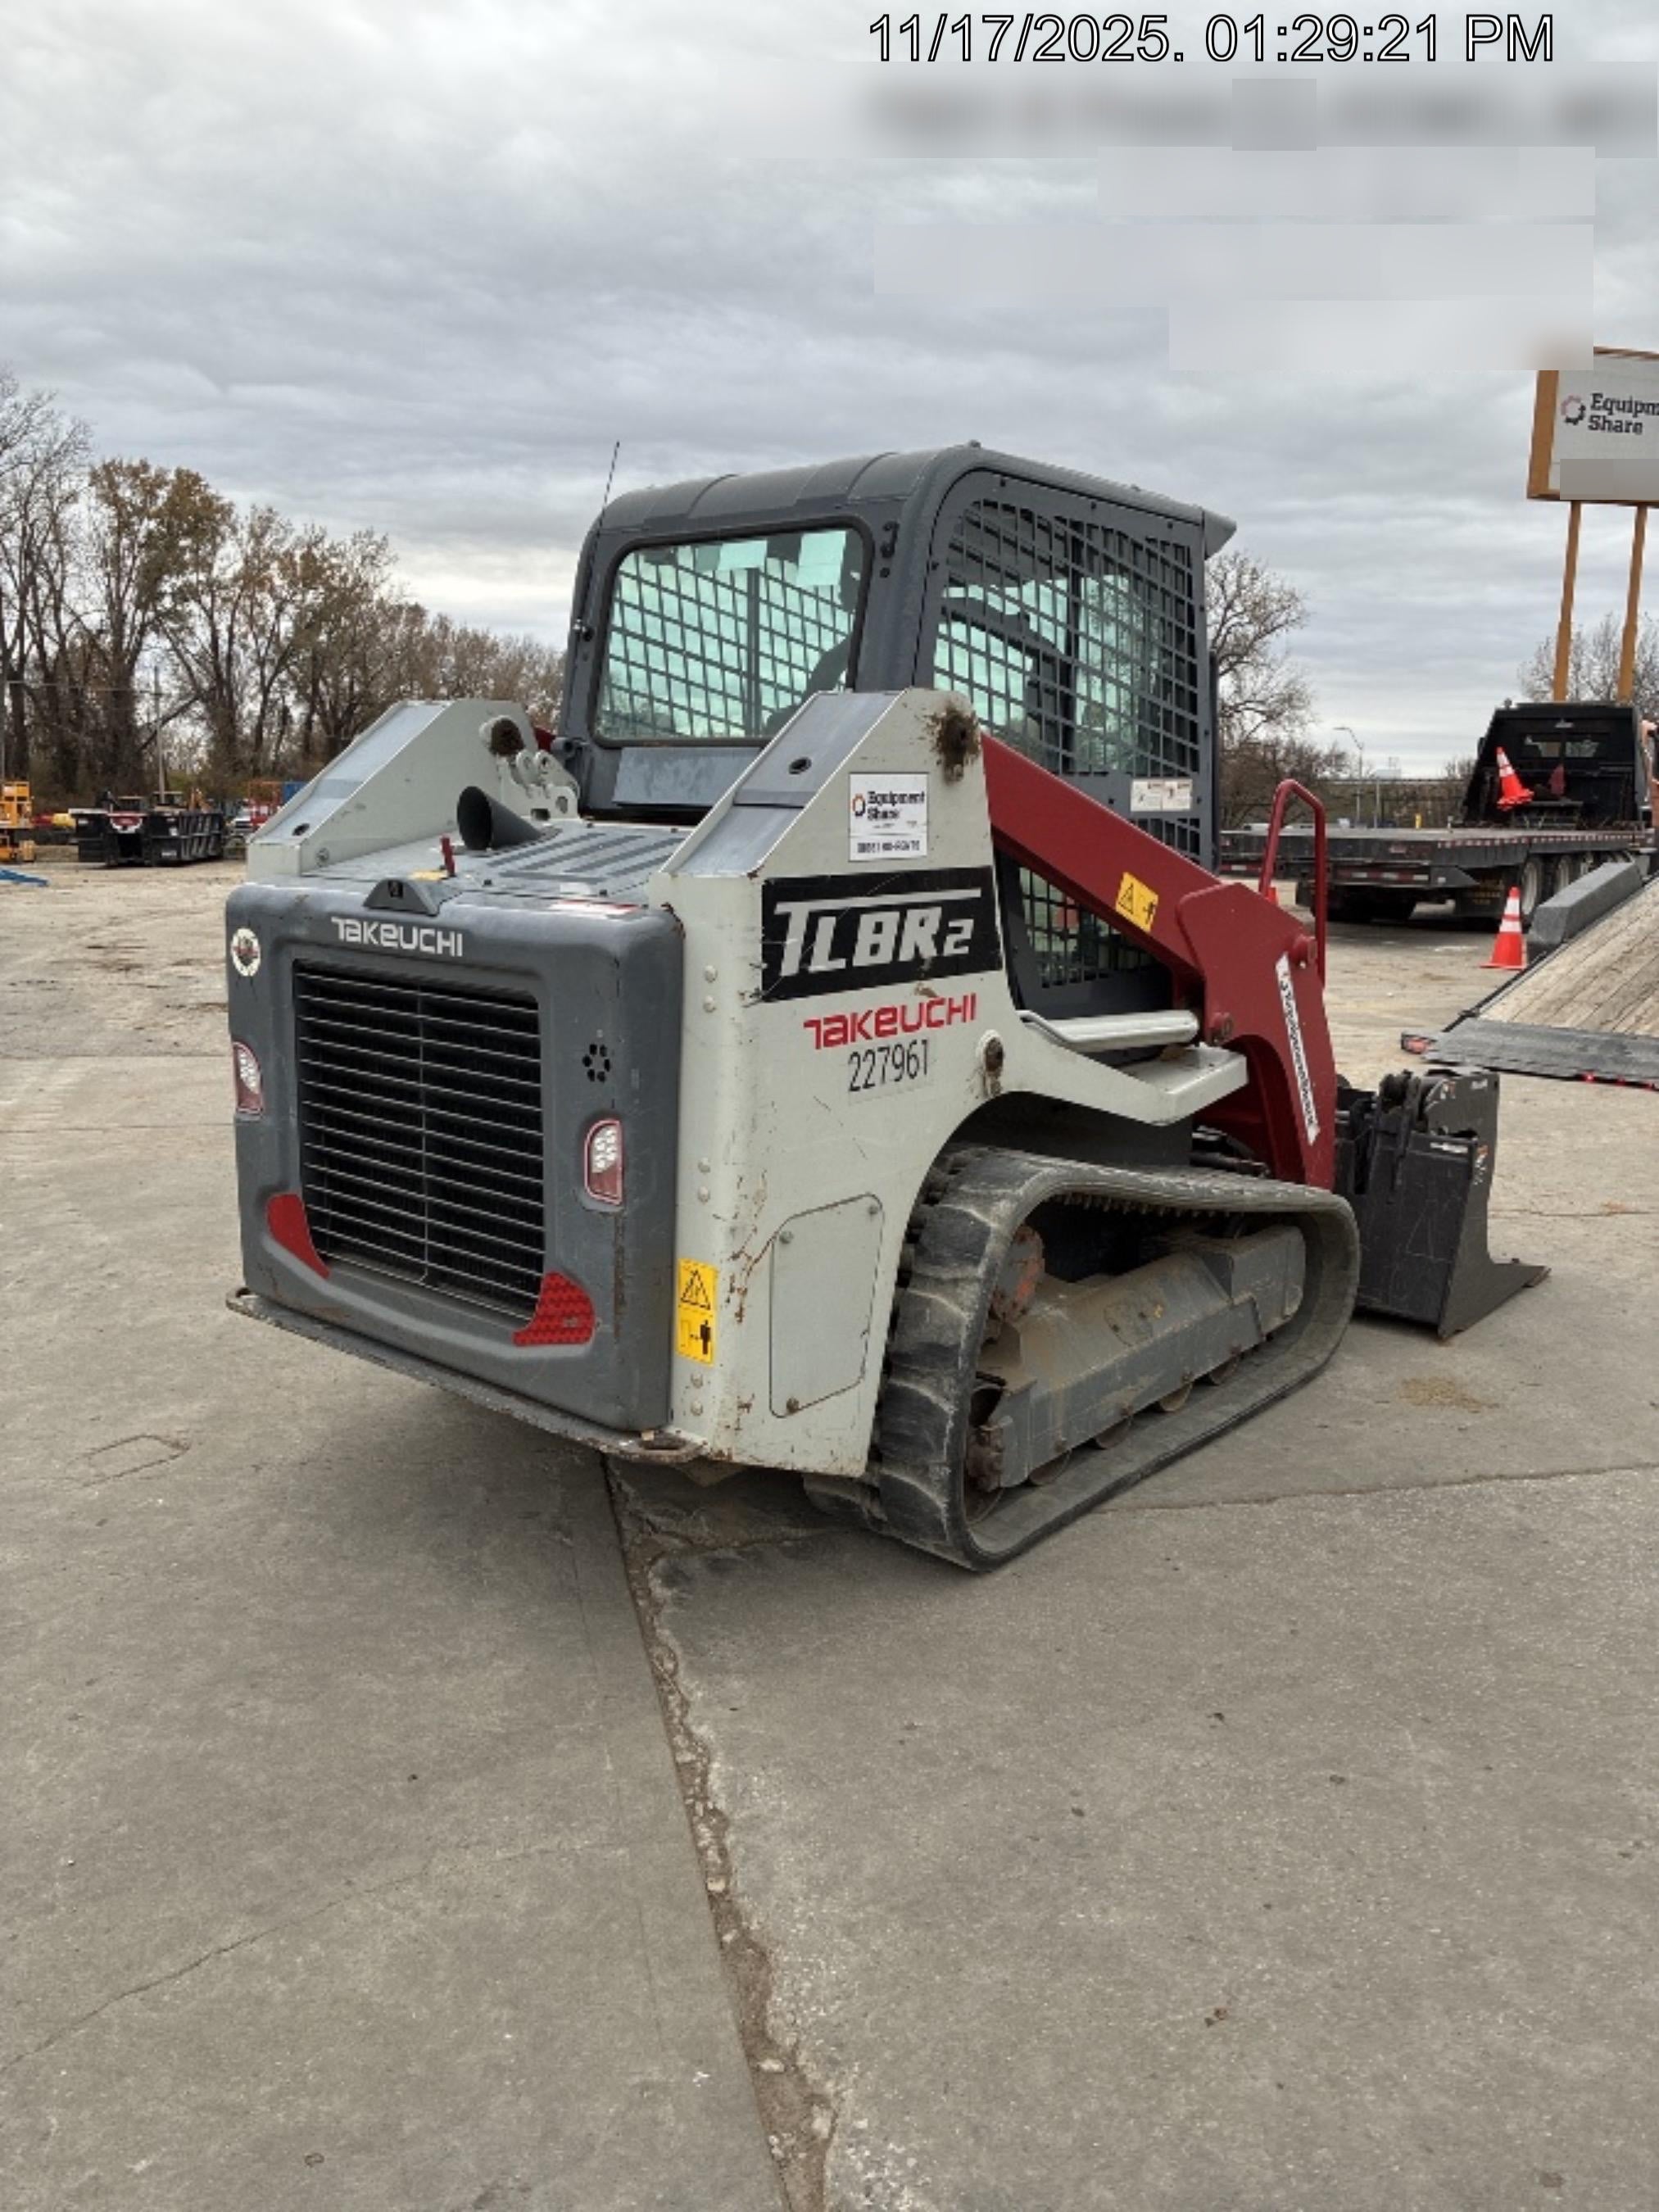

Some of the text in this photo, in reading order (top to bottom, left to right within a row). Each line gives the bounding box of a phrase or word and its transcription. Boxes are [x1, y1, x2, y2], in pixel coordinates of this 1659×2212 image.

[1588, 415, 1643, 435] Share
[867, 791, 925, 807] Equipment
[867, 806, 900, 821] Share
[331, 916, 464, 957] TAKEUCHI
[803, 993, 977, 1049] TAKEUCHI
[848, 1039, 929, 1092] 227961
